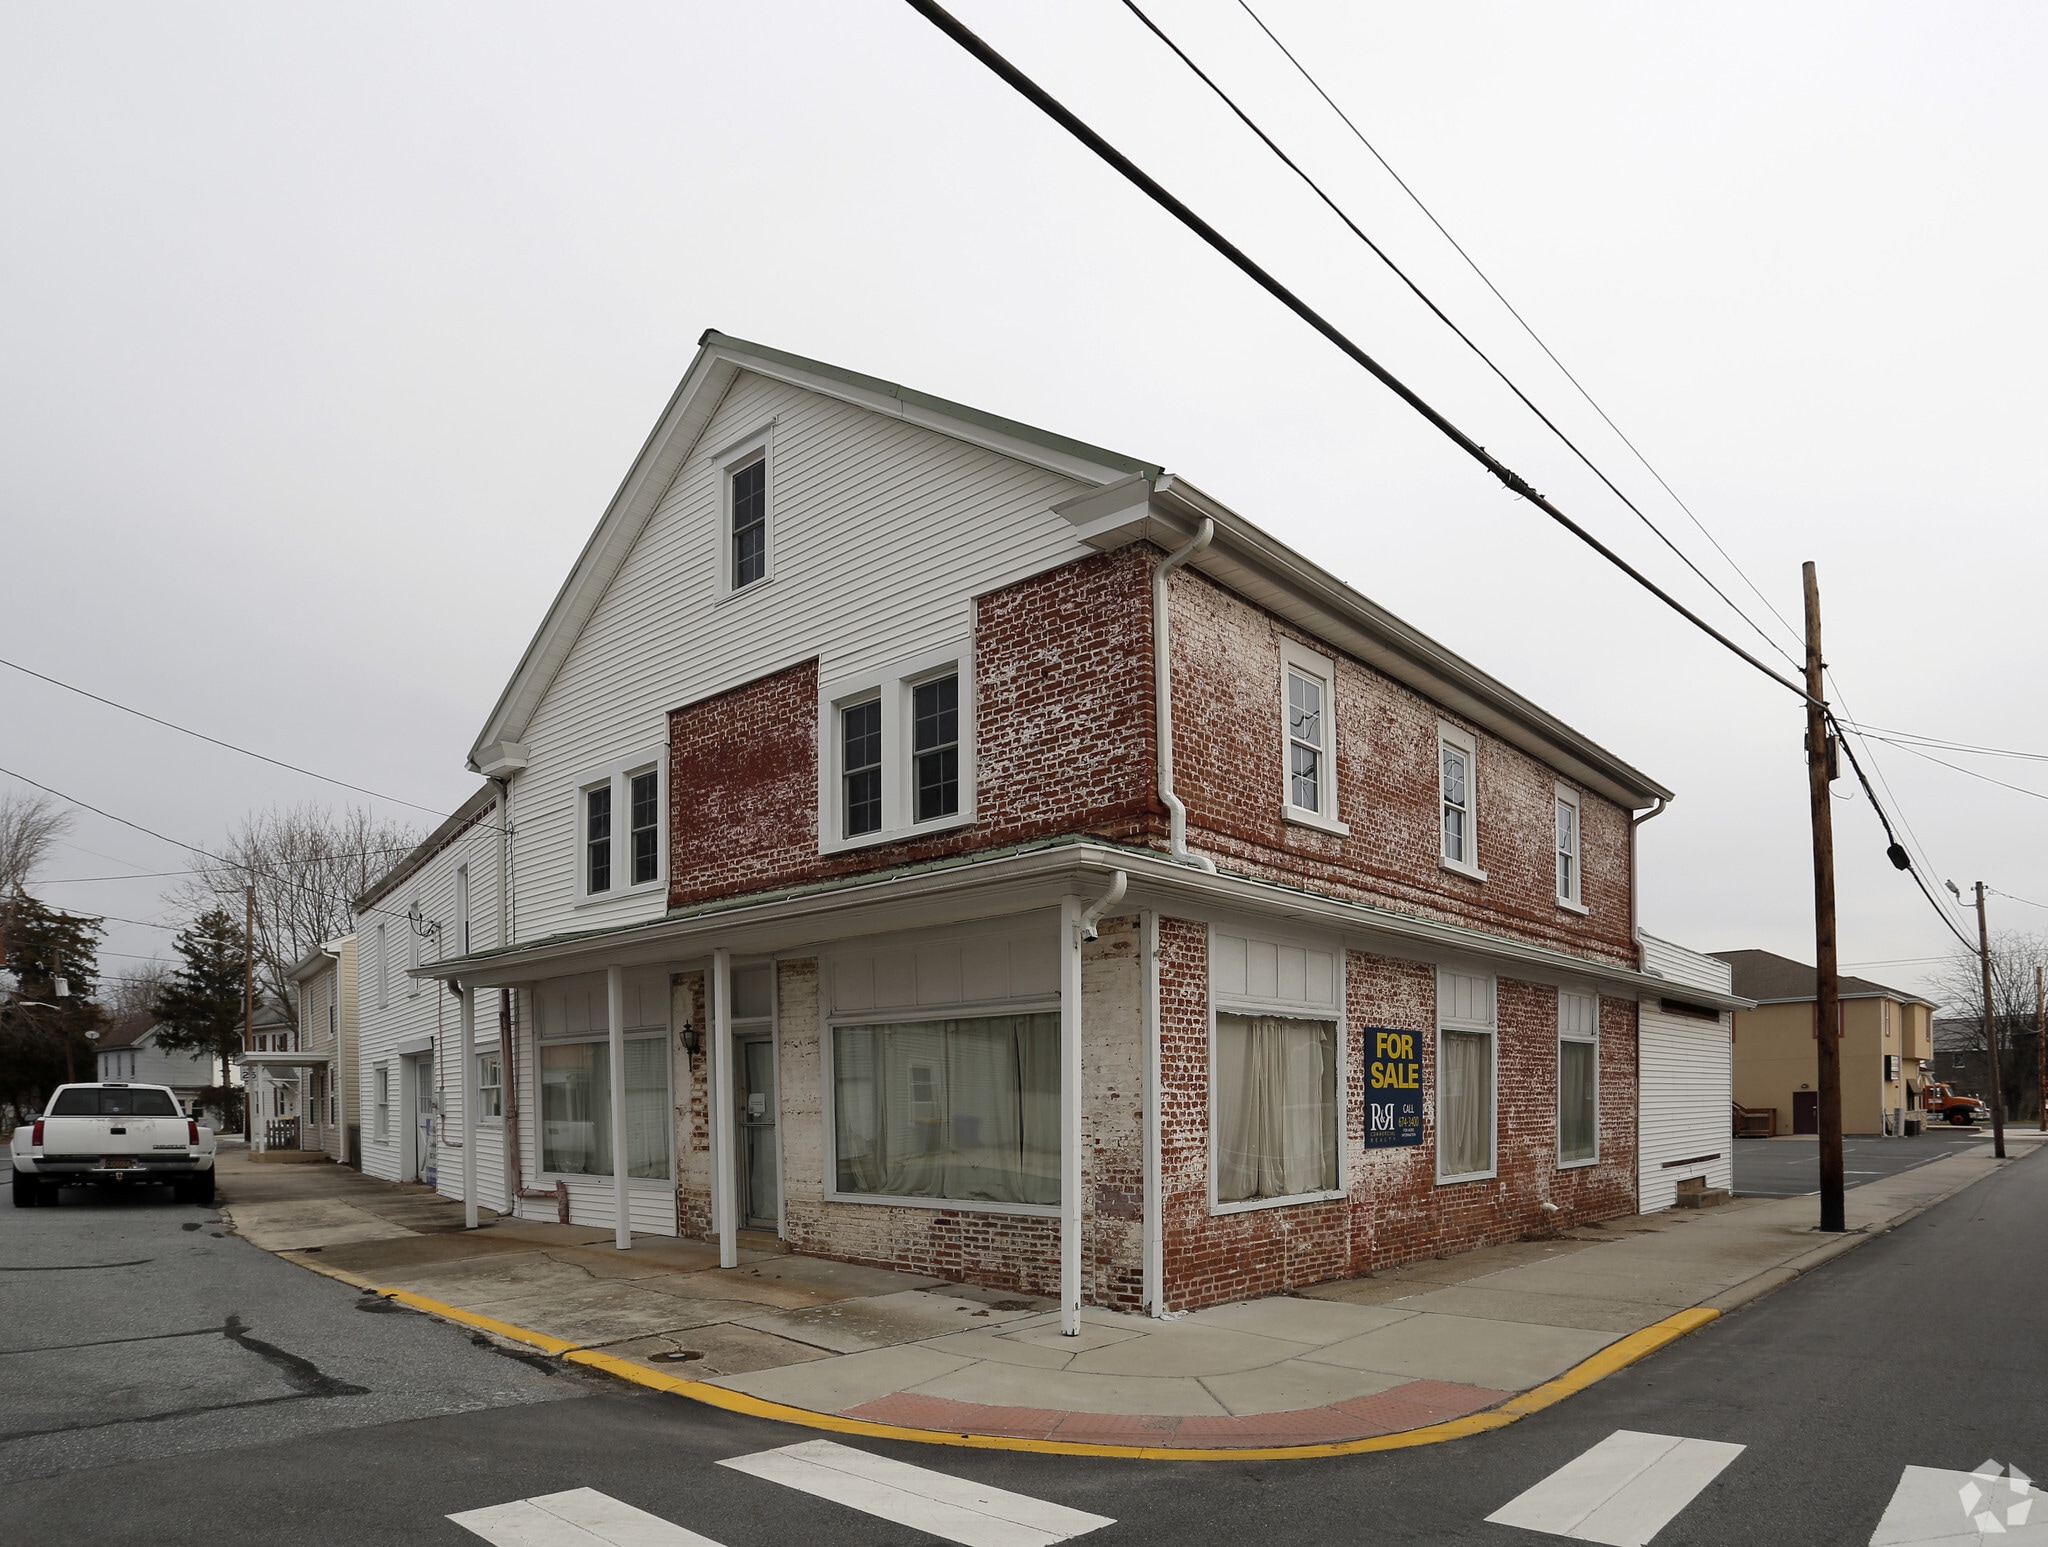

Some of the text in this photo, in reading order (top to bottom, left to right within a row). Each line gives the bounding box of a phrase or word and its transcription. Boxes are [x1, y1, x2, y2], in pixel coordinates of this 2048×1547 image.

[1376, 1032, 1413, 1060] FOR
[243, 1071, 257, 1079] 25
[1371, 1061, 1419, 1089] SALE
[1402, 1103, 1415, 1114] CALL
